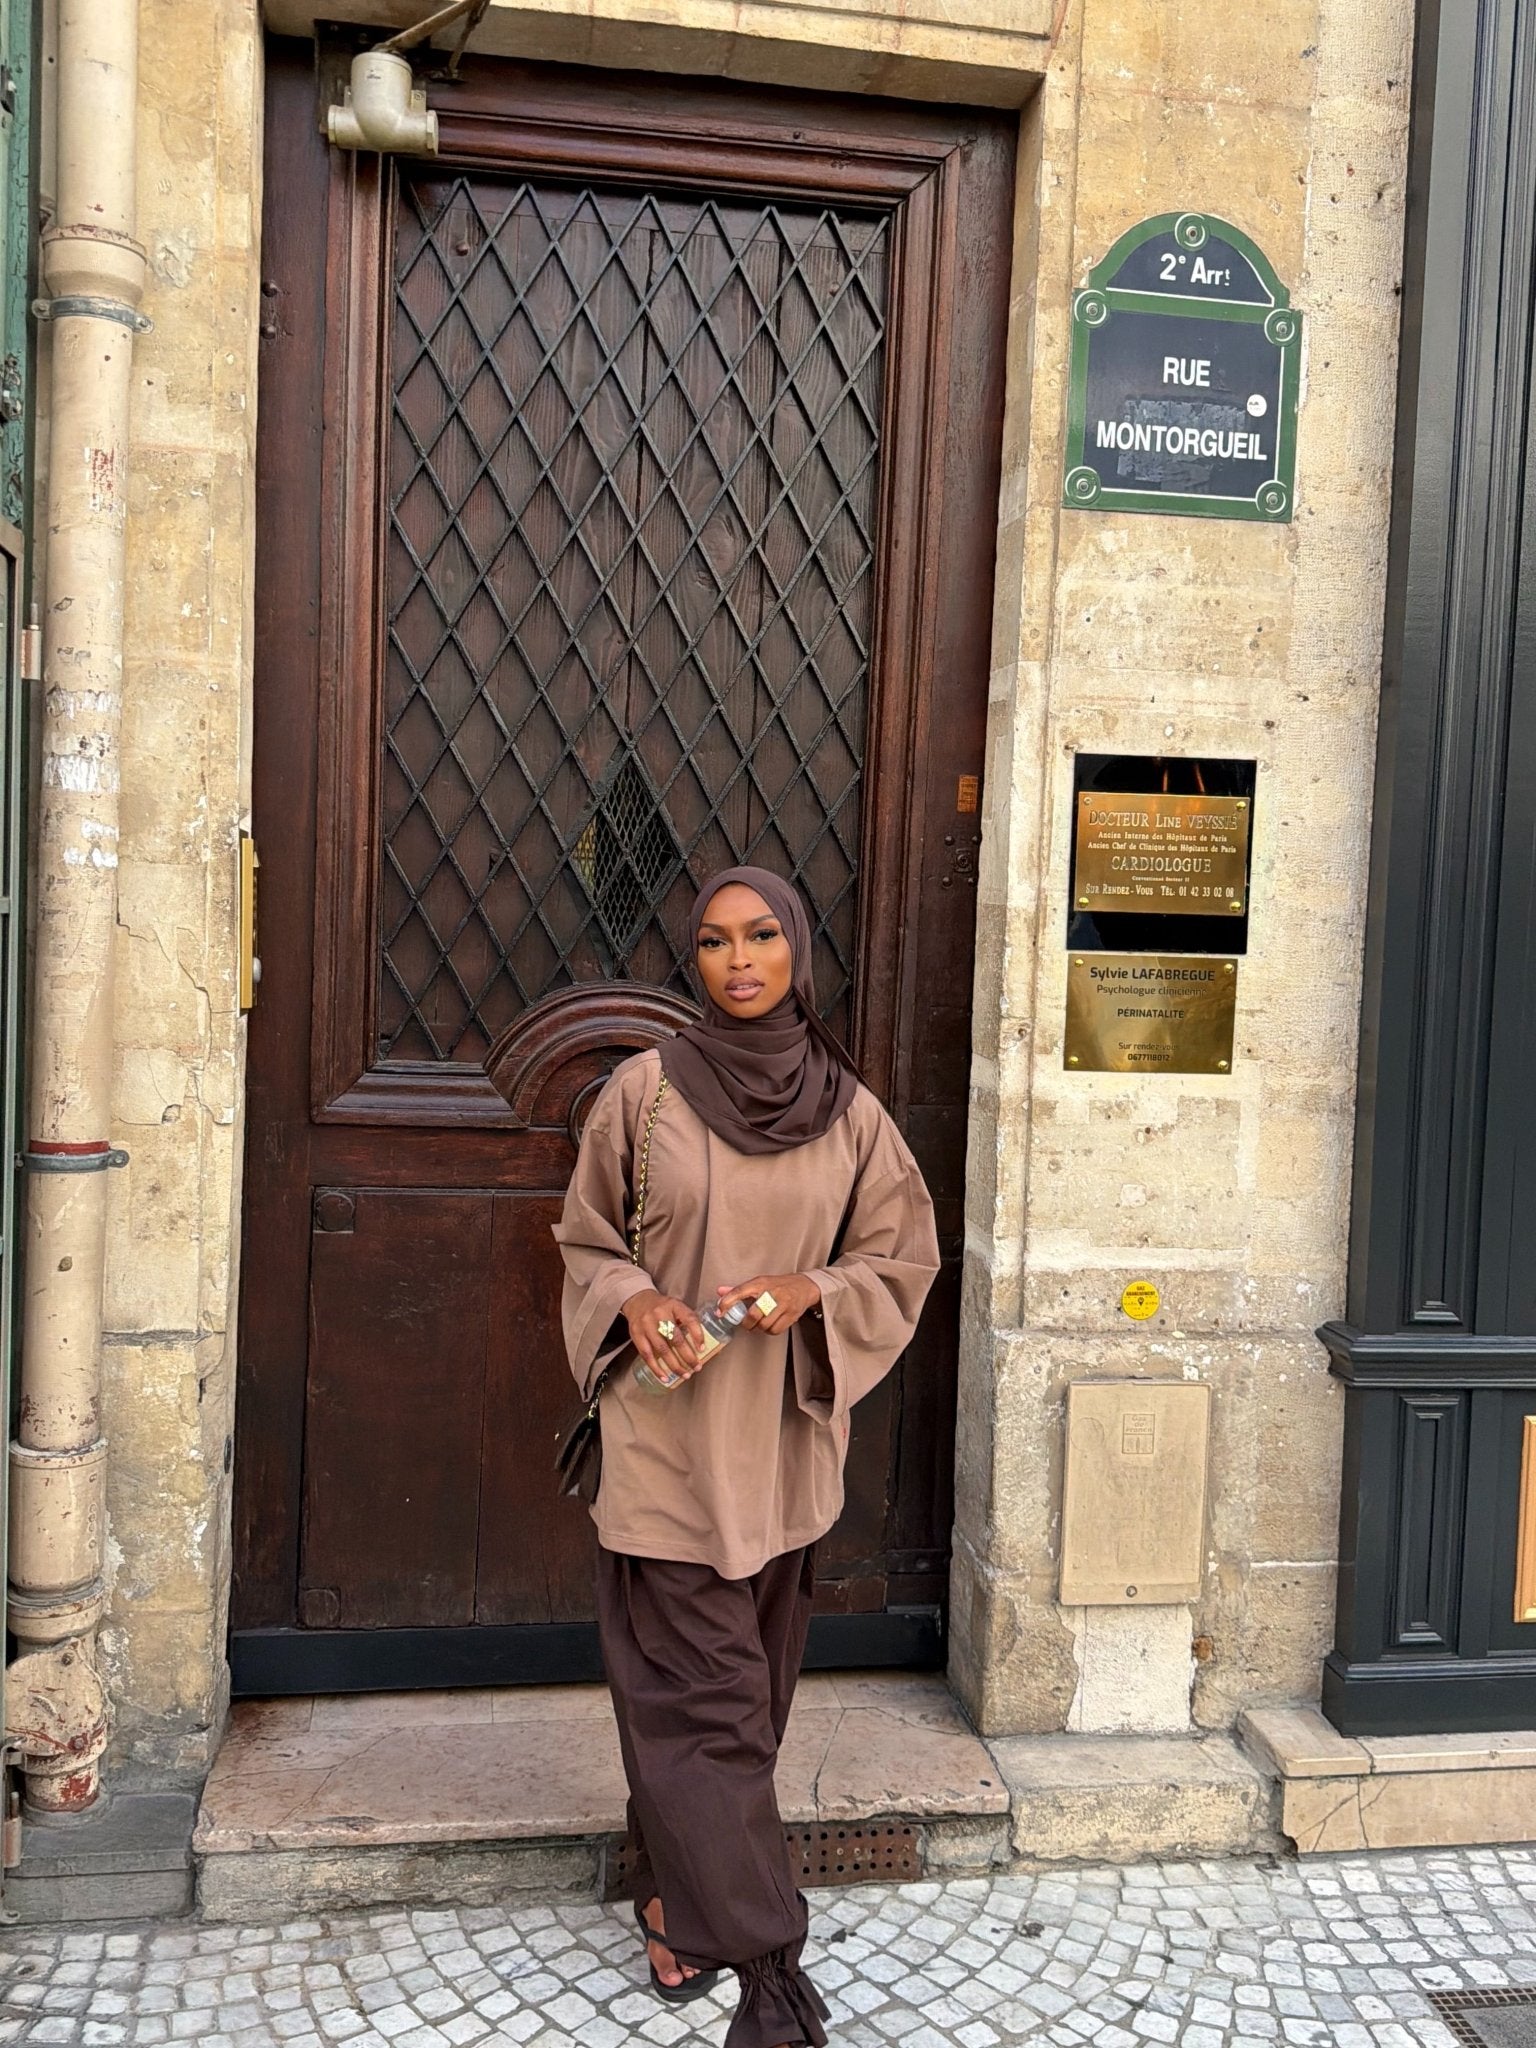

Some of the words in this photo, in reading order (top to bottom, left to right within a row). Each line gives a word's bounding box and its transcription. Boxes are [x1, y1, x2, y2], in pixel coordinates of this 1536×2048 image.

[1162, 356, 1211, 387] RUE
[1096, 420, 1268, 461] MONTORGUEIL
[1088, 811, 1150, 827] DOCTEUR
[1124, 832, 1149, 840] Interne
[1199, 834, 1208, 842] de
[1210, 834, 1228, 842] Paris
[1112, 842, 1127, 850] Chef
[1139, 843, 1165, 852] Clinique
[1210, 845, 1219, 853] de
[1221, 845, 1237, 853] Paris
[1111, 856, 1212, 873] CARDIOLOGUE
[1178, 886, 1187, 897] 01
[1190, 886, 1200, 897] 42
[1202, 886, 1211, 897] 33
[1213, 886, 1223, 898] 02
[1090, 967, 1129, 980] Sylvie
[1131, 968, 1216, 981] LAFABREGUE
[1096, 984, 1156, 996] Psychologue
[1118, 1042, 1132, 1050] Sur
